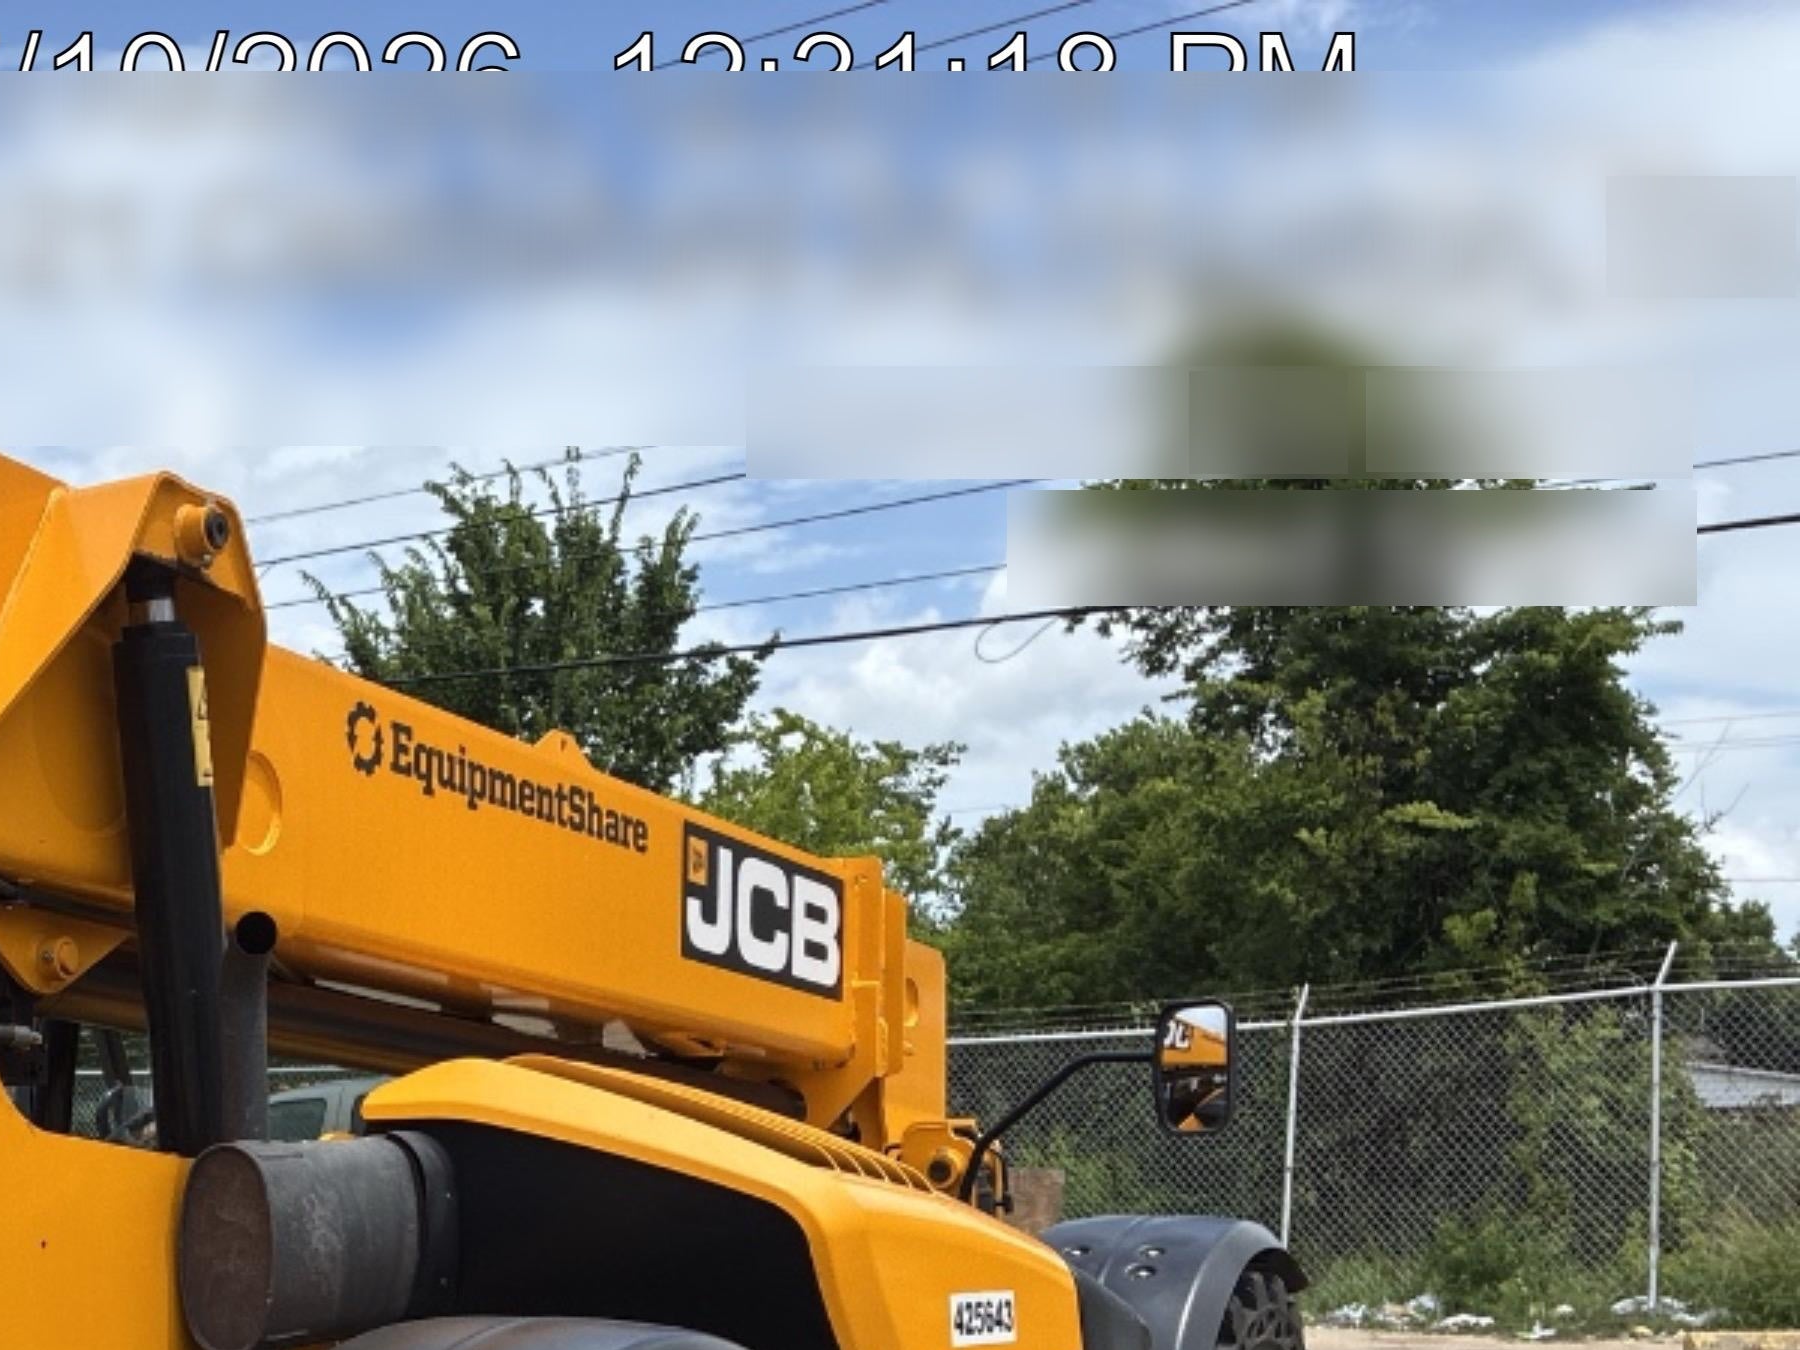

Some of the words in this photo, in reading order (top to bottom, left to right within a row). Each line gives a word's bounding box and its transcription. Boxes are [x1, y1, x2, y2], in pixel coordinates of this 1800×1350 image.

[389, 721, 648, 854] EquipmentShare
[685, 845, 841, 988] JCB
[953, 1298, 1013, 1336] 425643
